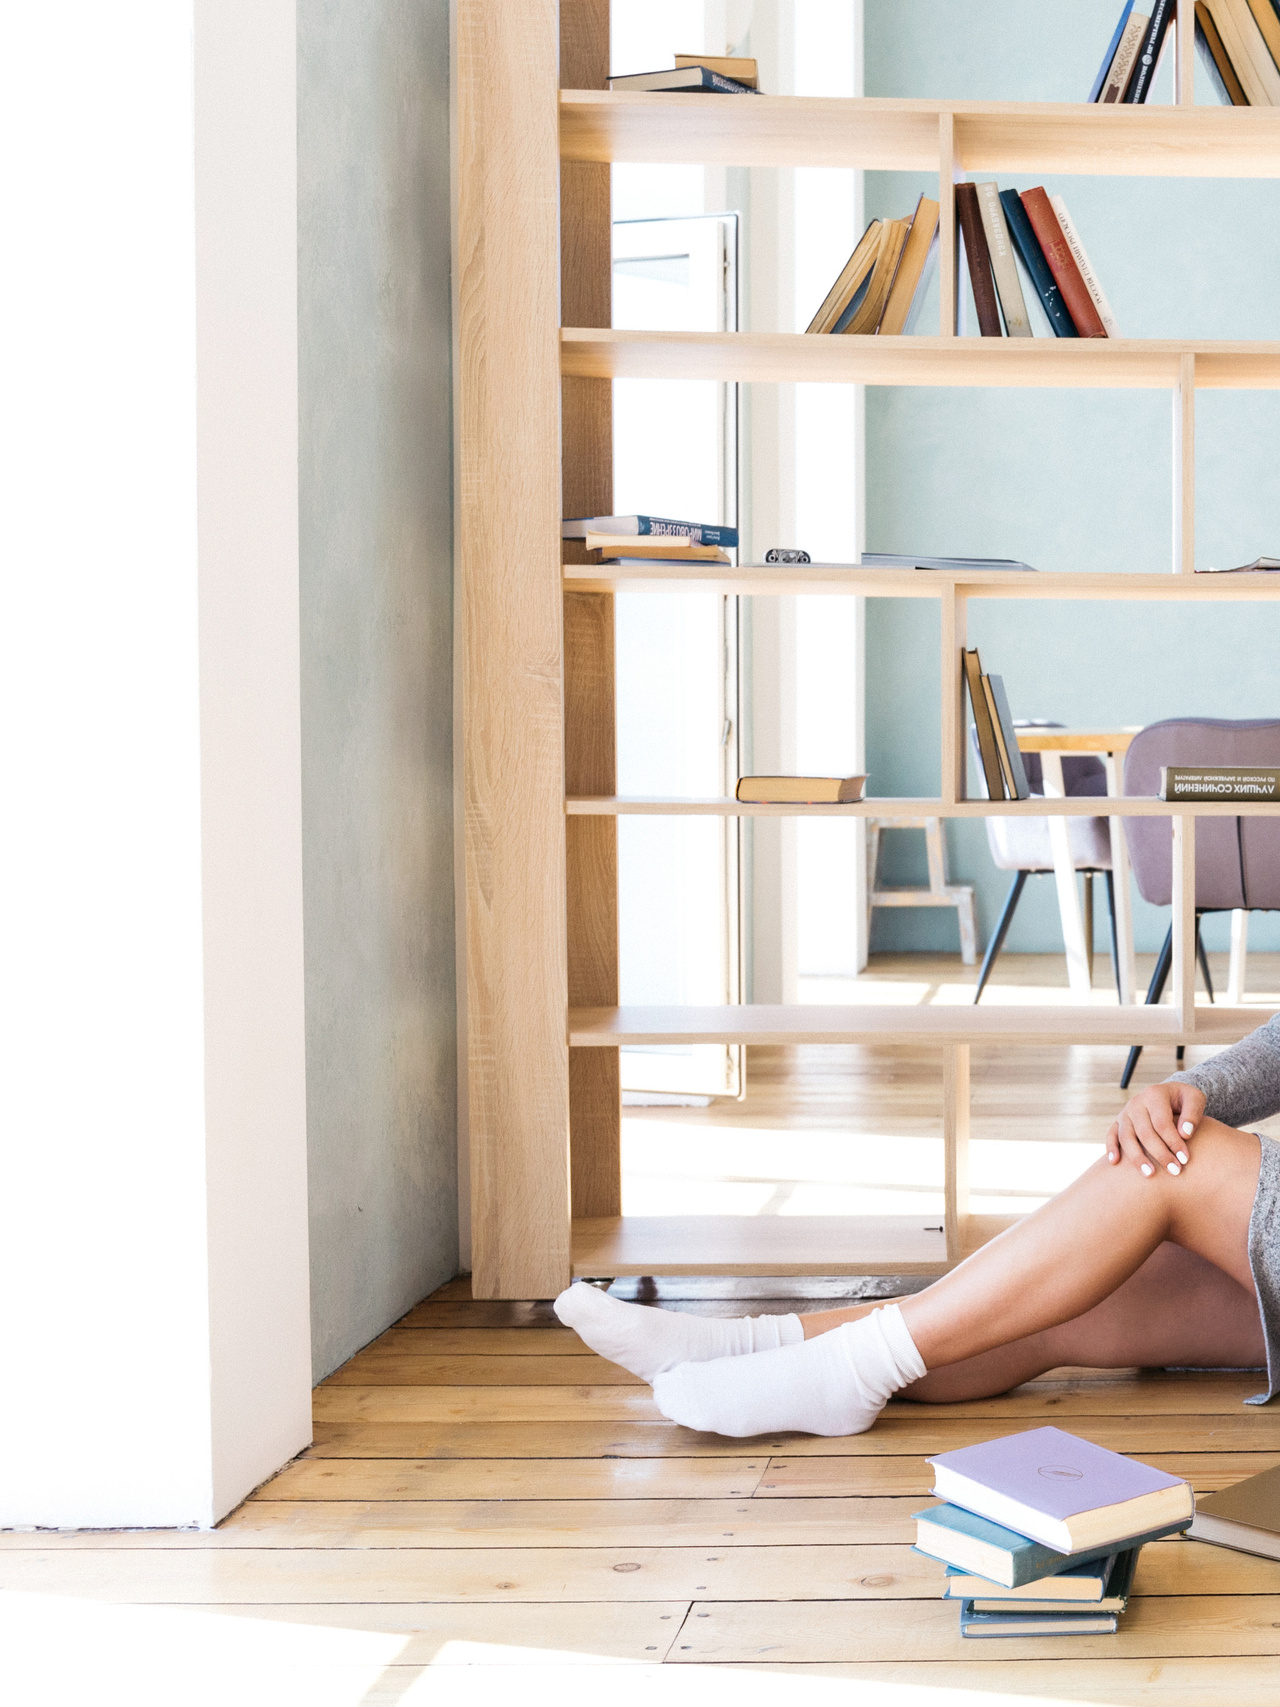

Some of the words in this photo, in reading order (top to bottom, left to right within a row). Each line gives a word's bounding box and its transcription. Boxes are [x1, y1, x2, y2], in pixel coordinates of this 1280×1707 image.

[1203, 775, 1236, 783] ЗАРУБЕЖНОЙ
[1242, 775, 1267, 783] РУССКОЙ
[1174, 783, 1233, 794] СОЧИНЕНИЙ
[1234, 784, 1275, 794] ЛУЧШИХ
